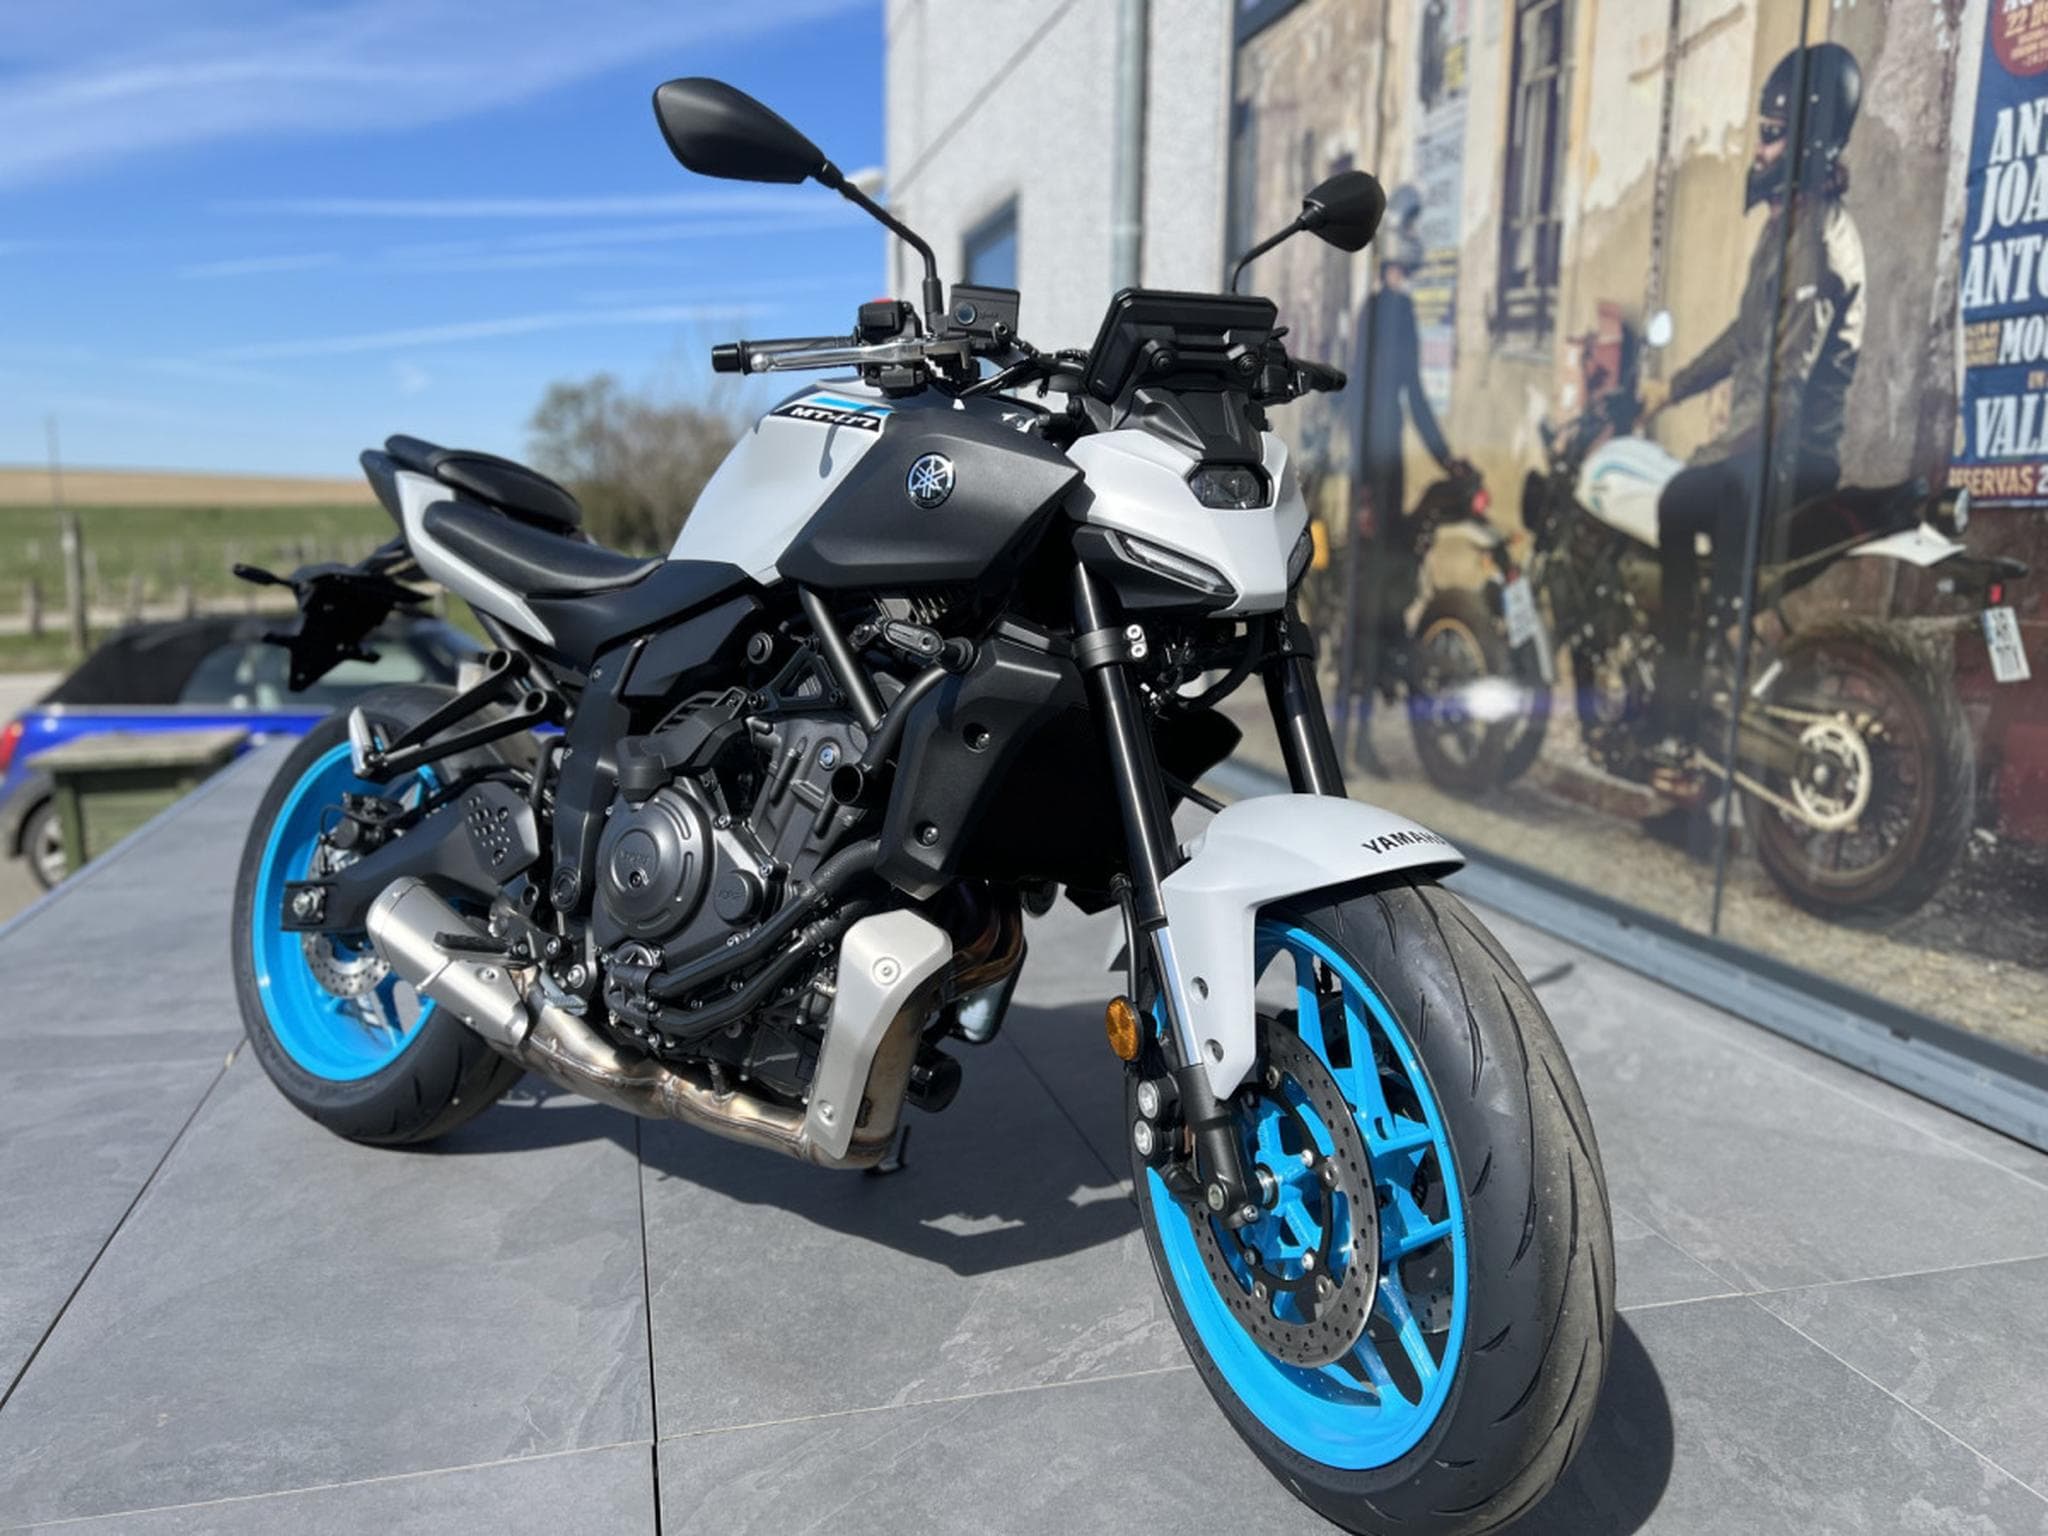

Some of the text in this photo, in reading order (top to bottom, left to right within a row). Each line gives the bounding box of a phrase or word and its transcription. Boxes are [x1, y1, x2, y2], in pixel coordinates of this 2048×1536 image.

[1989, 97, 2048, 165] AN
[1973, 155, 2048, 241] JOA
[1998, 315, 2048, 364] MO
[790, 407, 878, 427] MT-07
